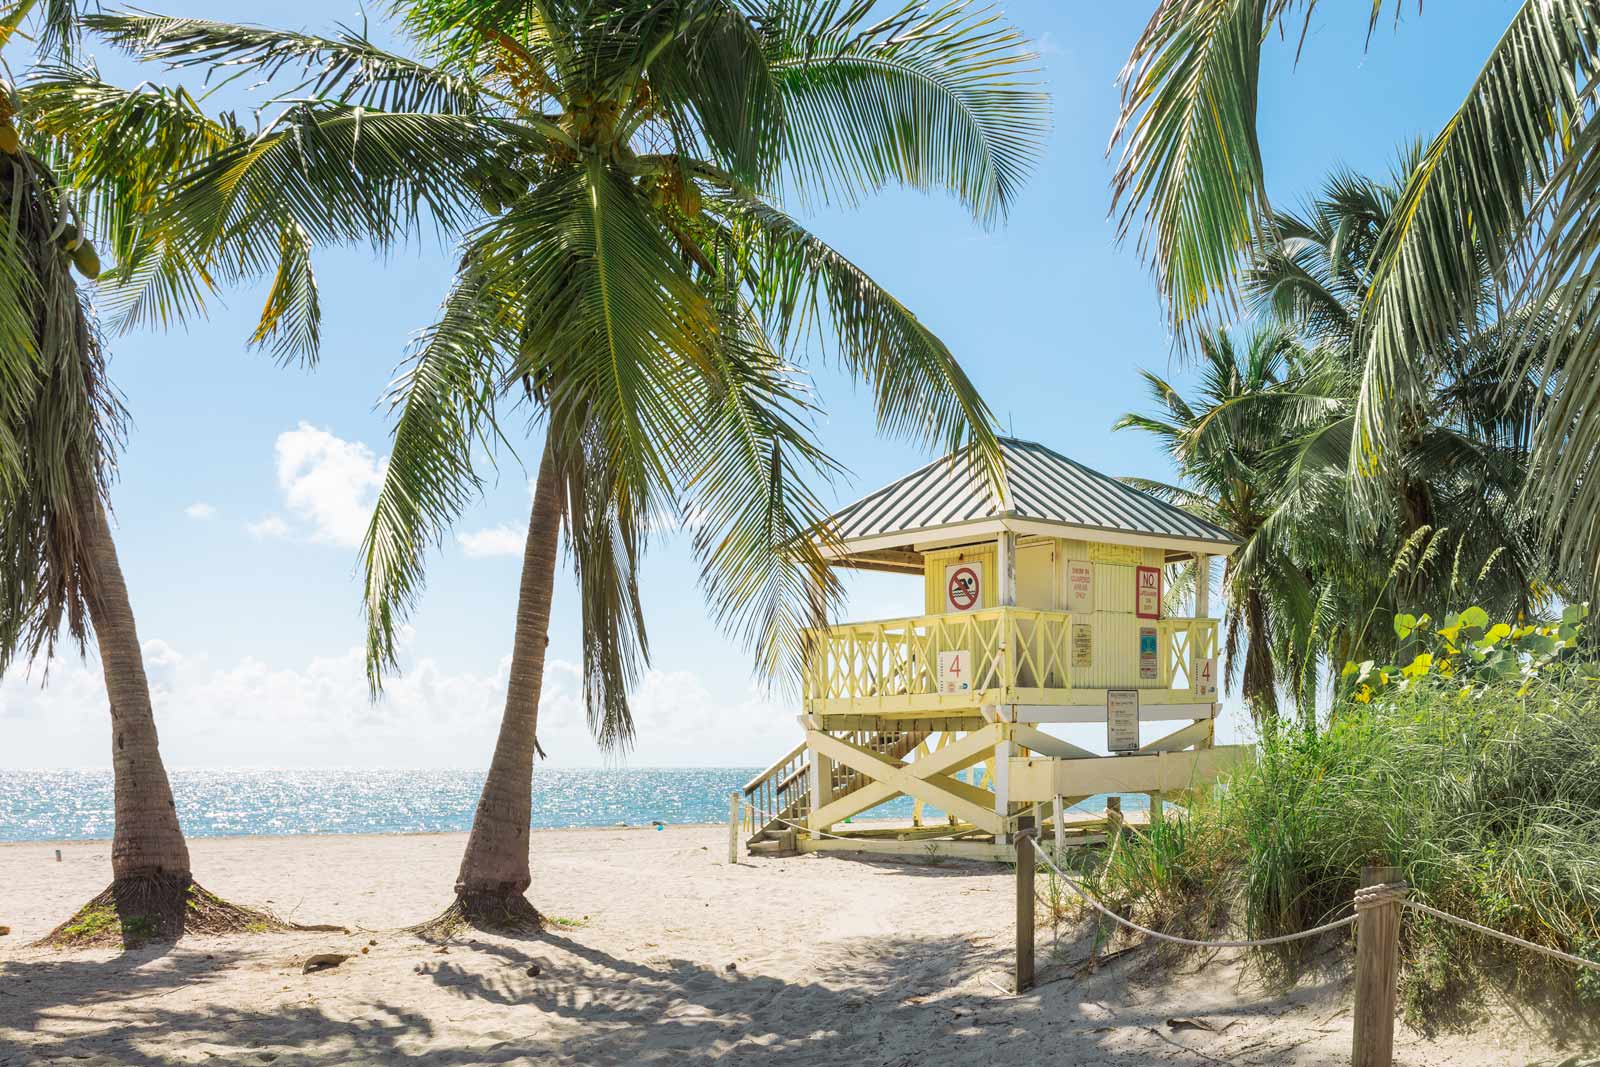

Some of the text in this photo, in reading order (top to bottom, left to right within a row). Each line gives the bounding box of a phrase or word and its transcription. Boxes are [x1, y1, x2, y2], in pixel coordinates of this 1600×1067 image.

[1143, 573, 1155, 586] NO
[949, 654, 961, 679] 4
[1202, 661, 1211, 682] 4
